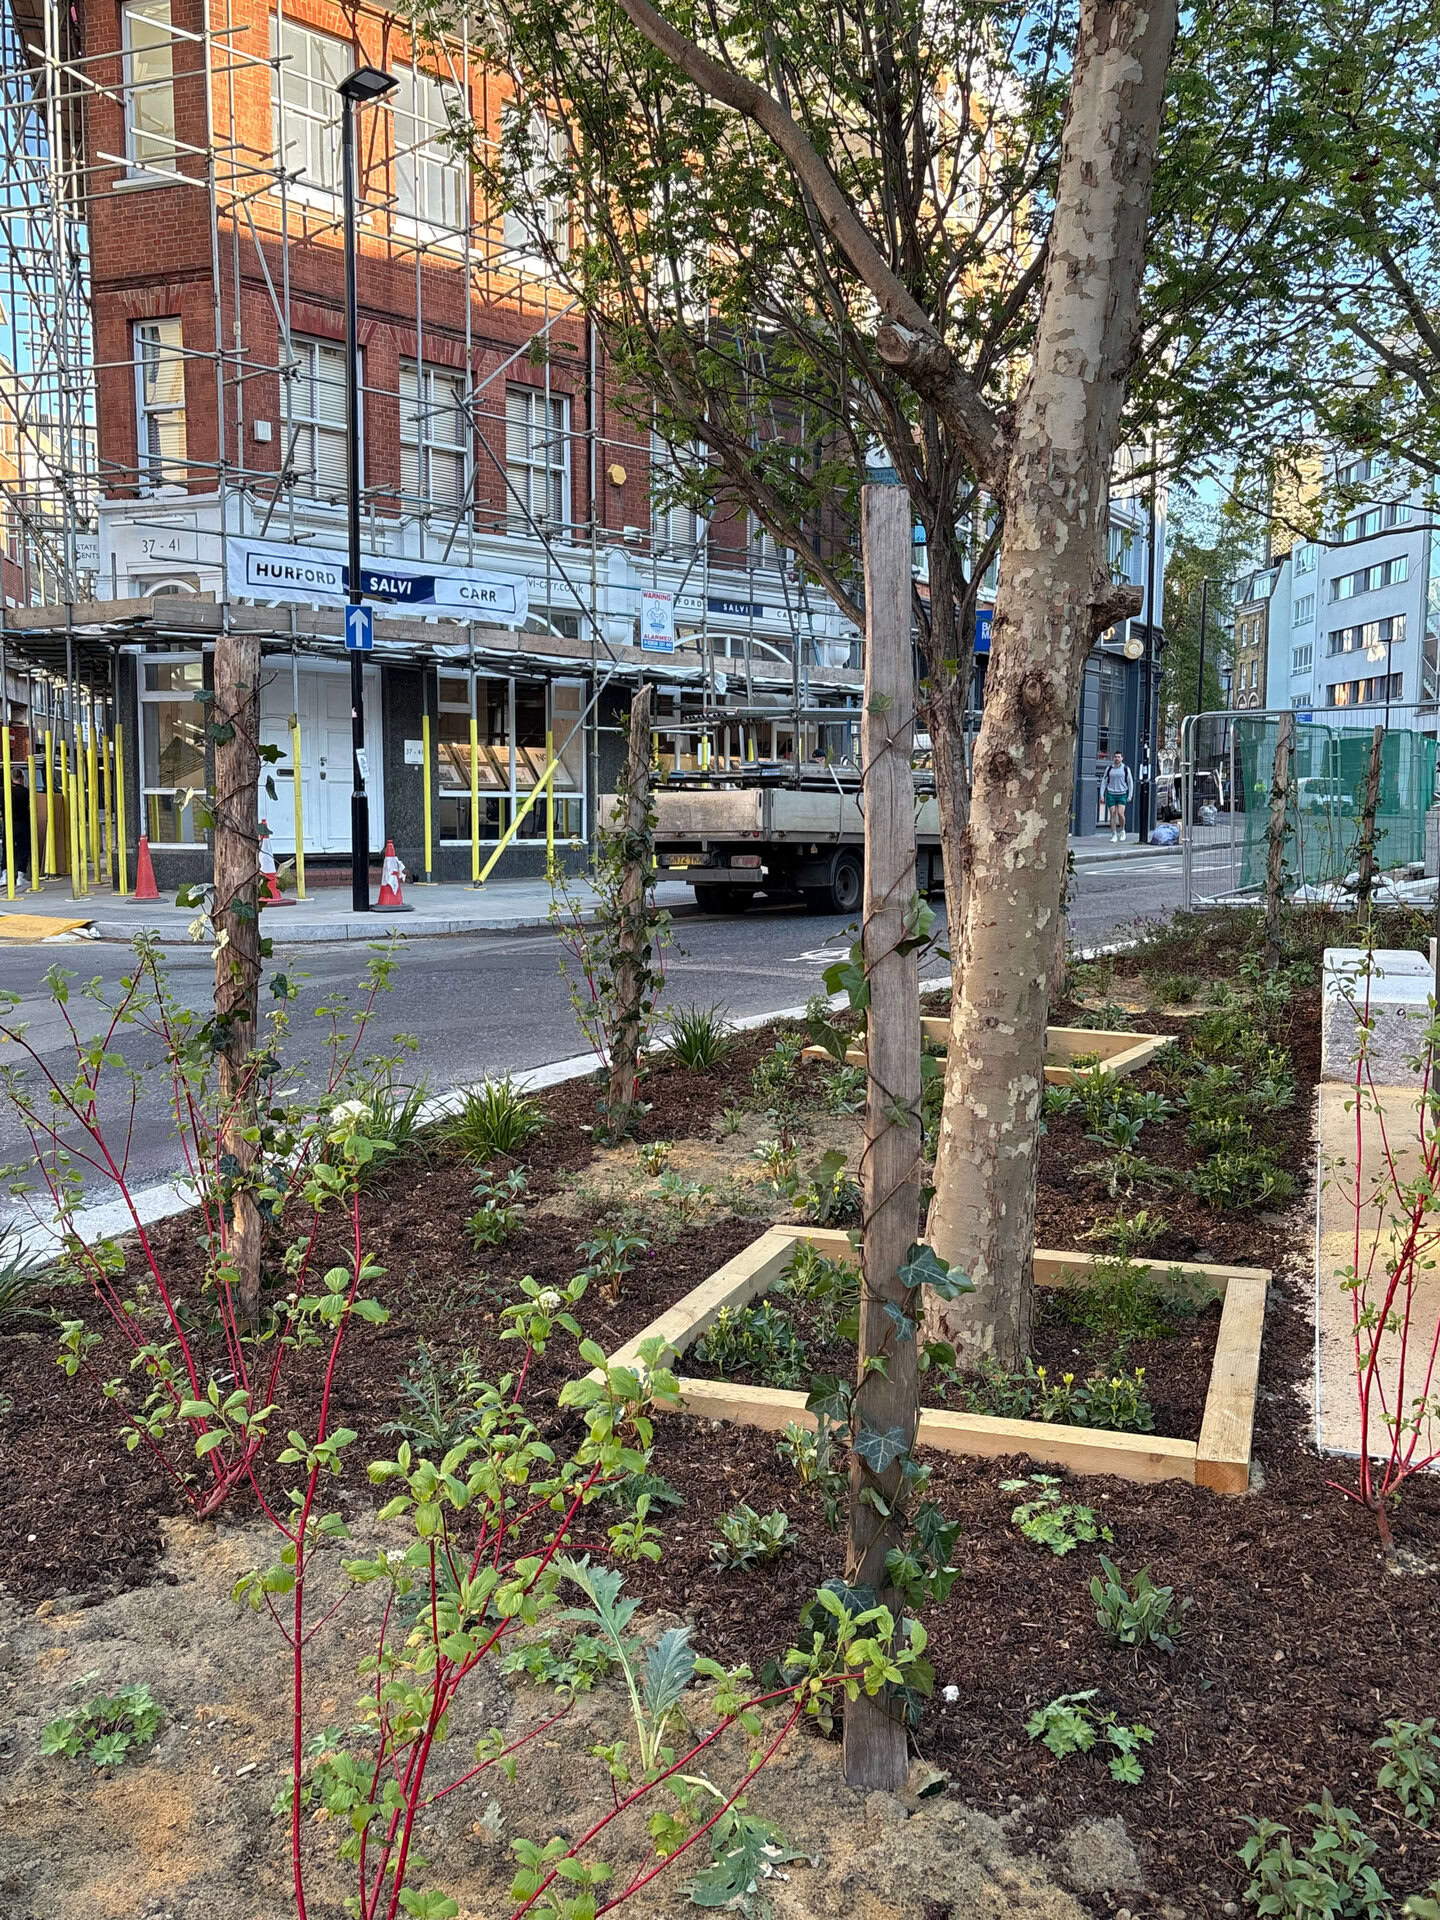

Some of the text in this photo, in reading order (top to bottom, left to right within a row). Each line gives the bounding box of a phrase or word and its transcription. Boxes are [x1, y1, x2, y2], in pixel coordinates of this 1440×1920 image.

[76, 543, 98, 551] STATE
[142, 539, 155, 553] 37
[168, 538, 180, 552] 41
[77, 552, 100, 560] GENTS
[255, 562, 497, 603] HURFORD SALVI CARR
[643, 591, 671, 602] WARNING
[677, 597, 799, 621] FORD SALVI CAR
[643, 633, 672, 642] ALARMED
